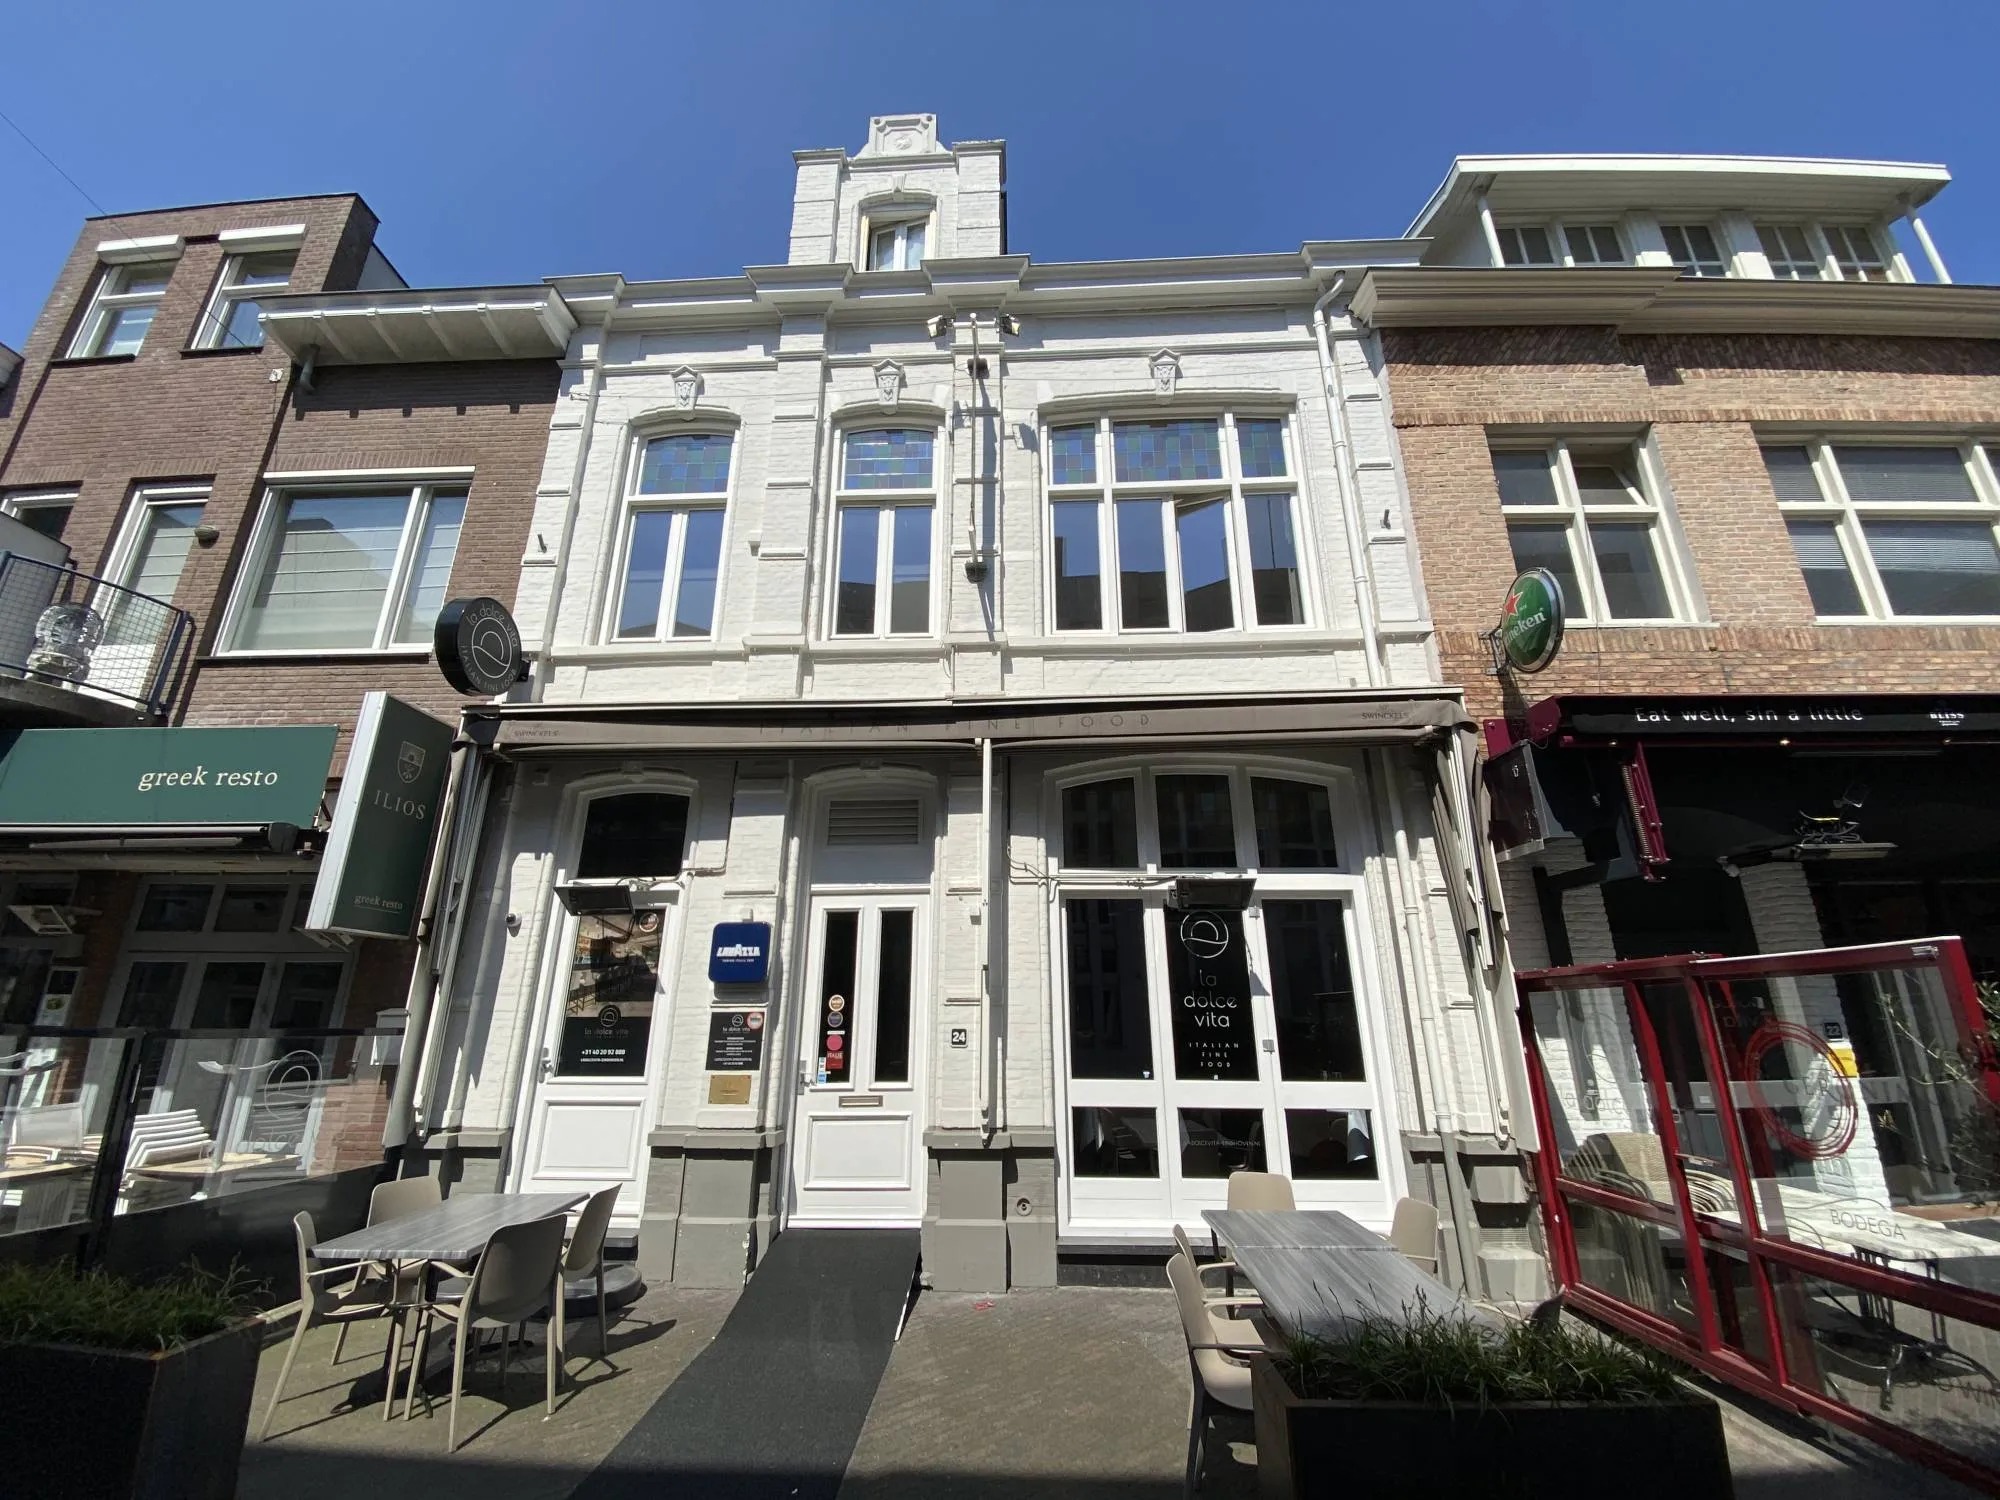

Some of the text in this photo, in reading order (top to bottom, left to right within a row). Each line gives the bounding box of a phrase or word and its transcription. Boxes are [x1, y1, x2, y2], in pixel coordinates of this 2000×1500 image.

[465, 603, 518, 648] la dolce vita
[1058, 713, 1150, 729] FOOD
[1635, 705, 1864, 723] Eat well, sin a little
[138, 765, 278, 792] greek resto
[374, 789, 426, 820] ILIOS
[353, 895, 403, 910] greek resto
[716, 943, 761, 957] LAVAZZA
[1199, 968, 1217, 986] la
[1184, 990, 1238, 1008] dolce
[1194, 1011, 1230, 1028] vita
[952, 1031, 966, 1042] 24
[1826, 1025, 1841, 1036] 22
[1829, 1208, 1907, 1240] BODEGA
